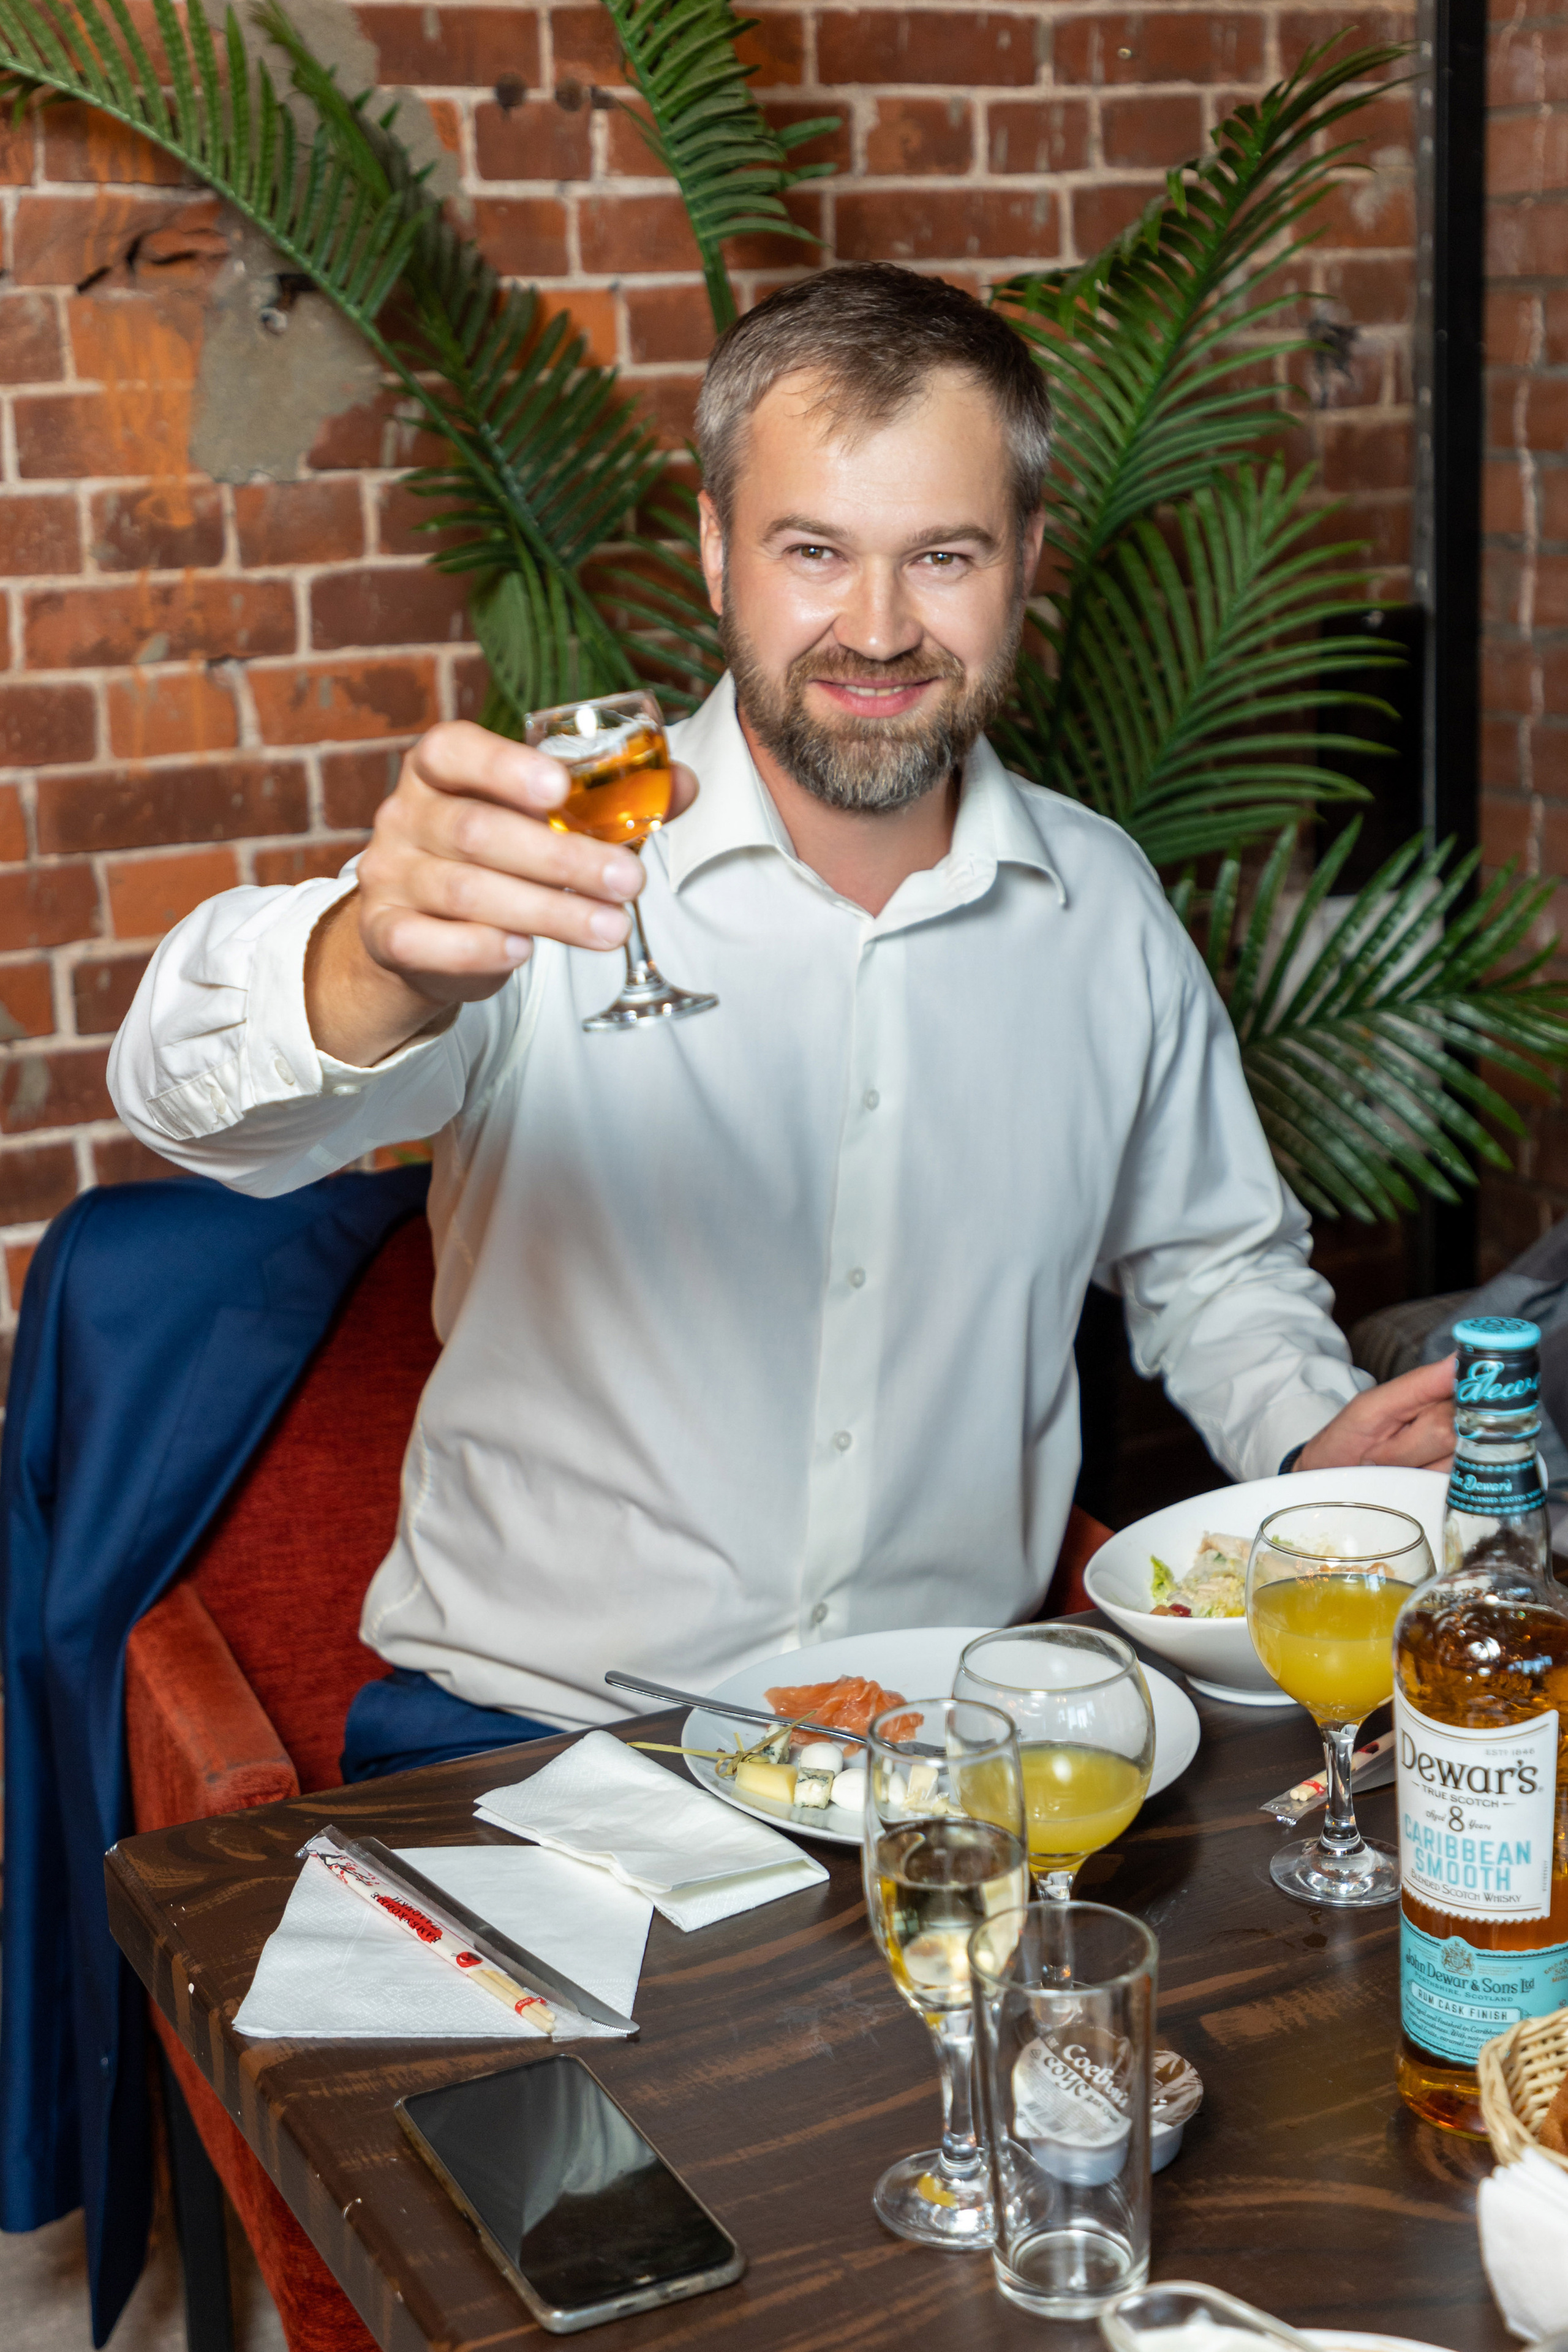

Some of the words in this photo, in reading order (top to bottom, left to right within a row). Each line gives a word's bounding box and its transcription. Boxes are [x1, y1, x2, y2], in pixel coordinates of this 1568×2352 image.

[1401, 1727, 1539, 1795] Dewar's
[1422, 1784, 1449, 1800] TRUE
[1450, 1794, 1499, 1808] SCOTCH
[1426, 1809, 1446, 1822] Aged
[1449, 1806, 1465, 1832] 8
[1469, 1819, 1491, 1830] Years
[1404, 1813, 1531, 1865] CARIBBEAN
[1415, 1847, 1511, 1891] SMOOTH
[1442, 1885, 1481, 1901] SCOTCH
[1483, 1892, 1522, 1903] WHISKY
[1406, 1948, 1426, 1974] John
[1427, 1962, 1469, 1989] Dewar
[1471, 1979, 1480, 1992] &
[1482, 1978, 1518, 1994] Sons
[518, 1998, 531, 2007] OPEN
[1418, 1989, 1434, 2005] RUM
[1438, 1999, 1464, 2015] CASK
[1469, 2008, 1507, 2020] FINISH
[1465, 1992, 1514, 2003] SCOTLAND
[1044, 2057, 1090, 2097] соус
[1063, 2044, 1129, 2108] Соевый
